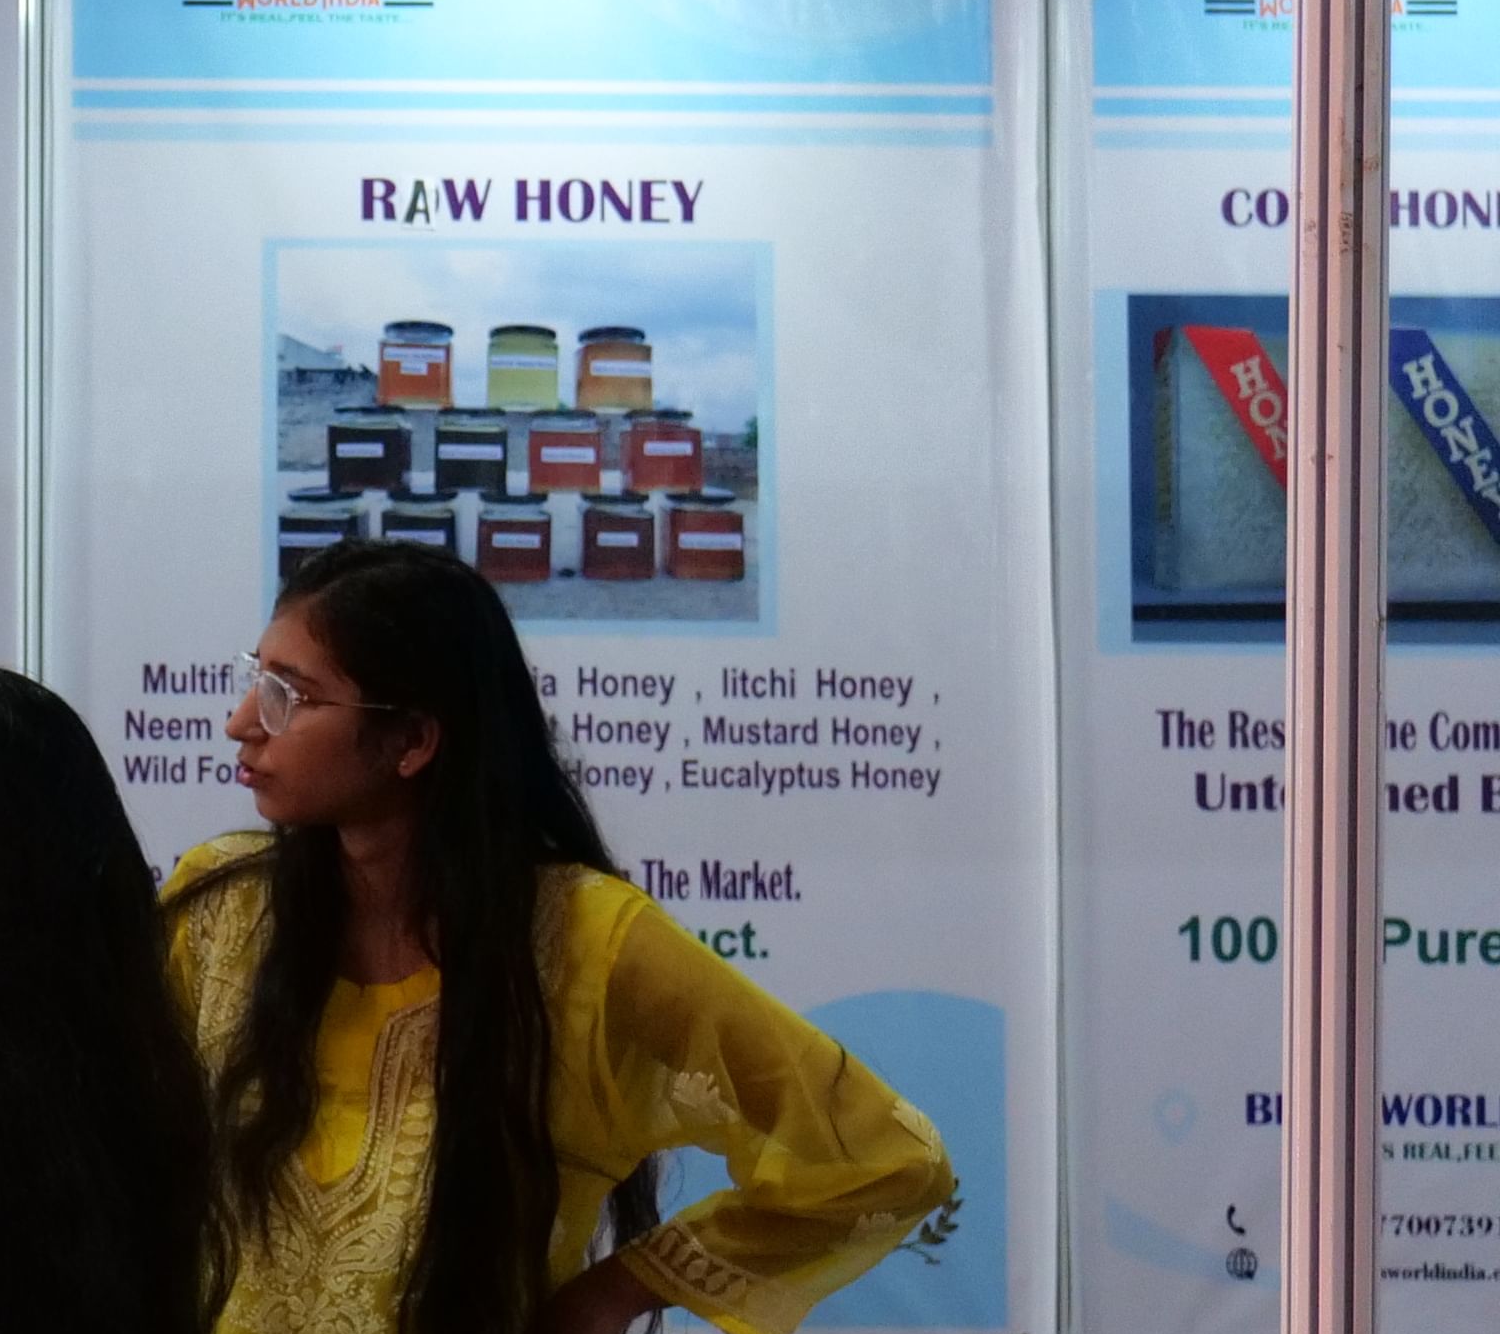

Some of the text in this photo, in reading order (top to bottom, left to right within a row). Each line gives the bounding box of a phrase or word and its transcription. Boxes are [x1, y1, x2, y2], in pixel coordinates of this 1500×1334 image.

[361, 178, 702, 225] RAW HONEY
[578, 667, 675, 706] Honey
[817, 669, 912, 707] Honey
[126, 710, 211, 740] Neem
[572, 713, 670, 752] Honey
[704, 717, 818, 745] Mustard
[832, 718, 921, 753] Honey
[1158, 711, 1214, 748] The
[124, 756, 185, 783] Wild
[682, 760, 840, 795] Eucalyptus
[852, 761, 940, 797] Honey
[641, 859, 690, 900] The
[701, 860, 800, 900] Market.
[1382, 1093, 1500, 1127] WORL
